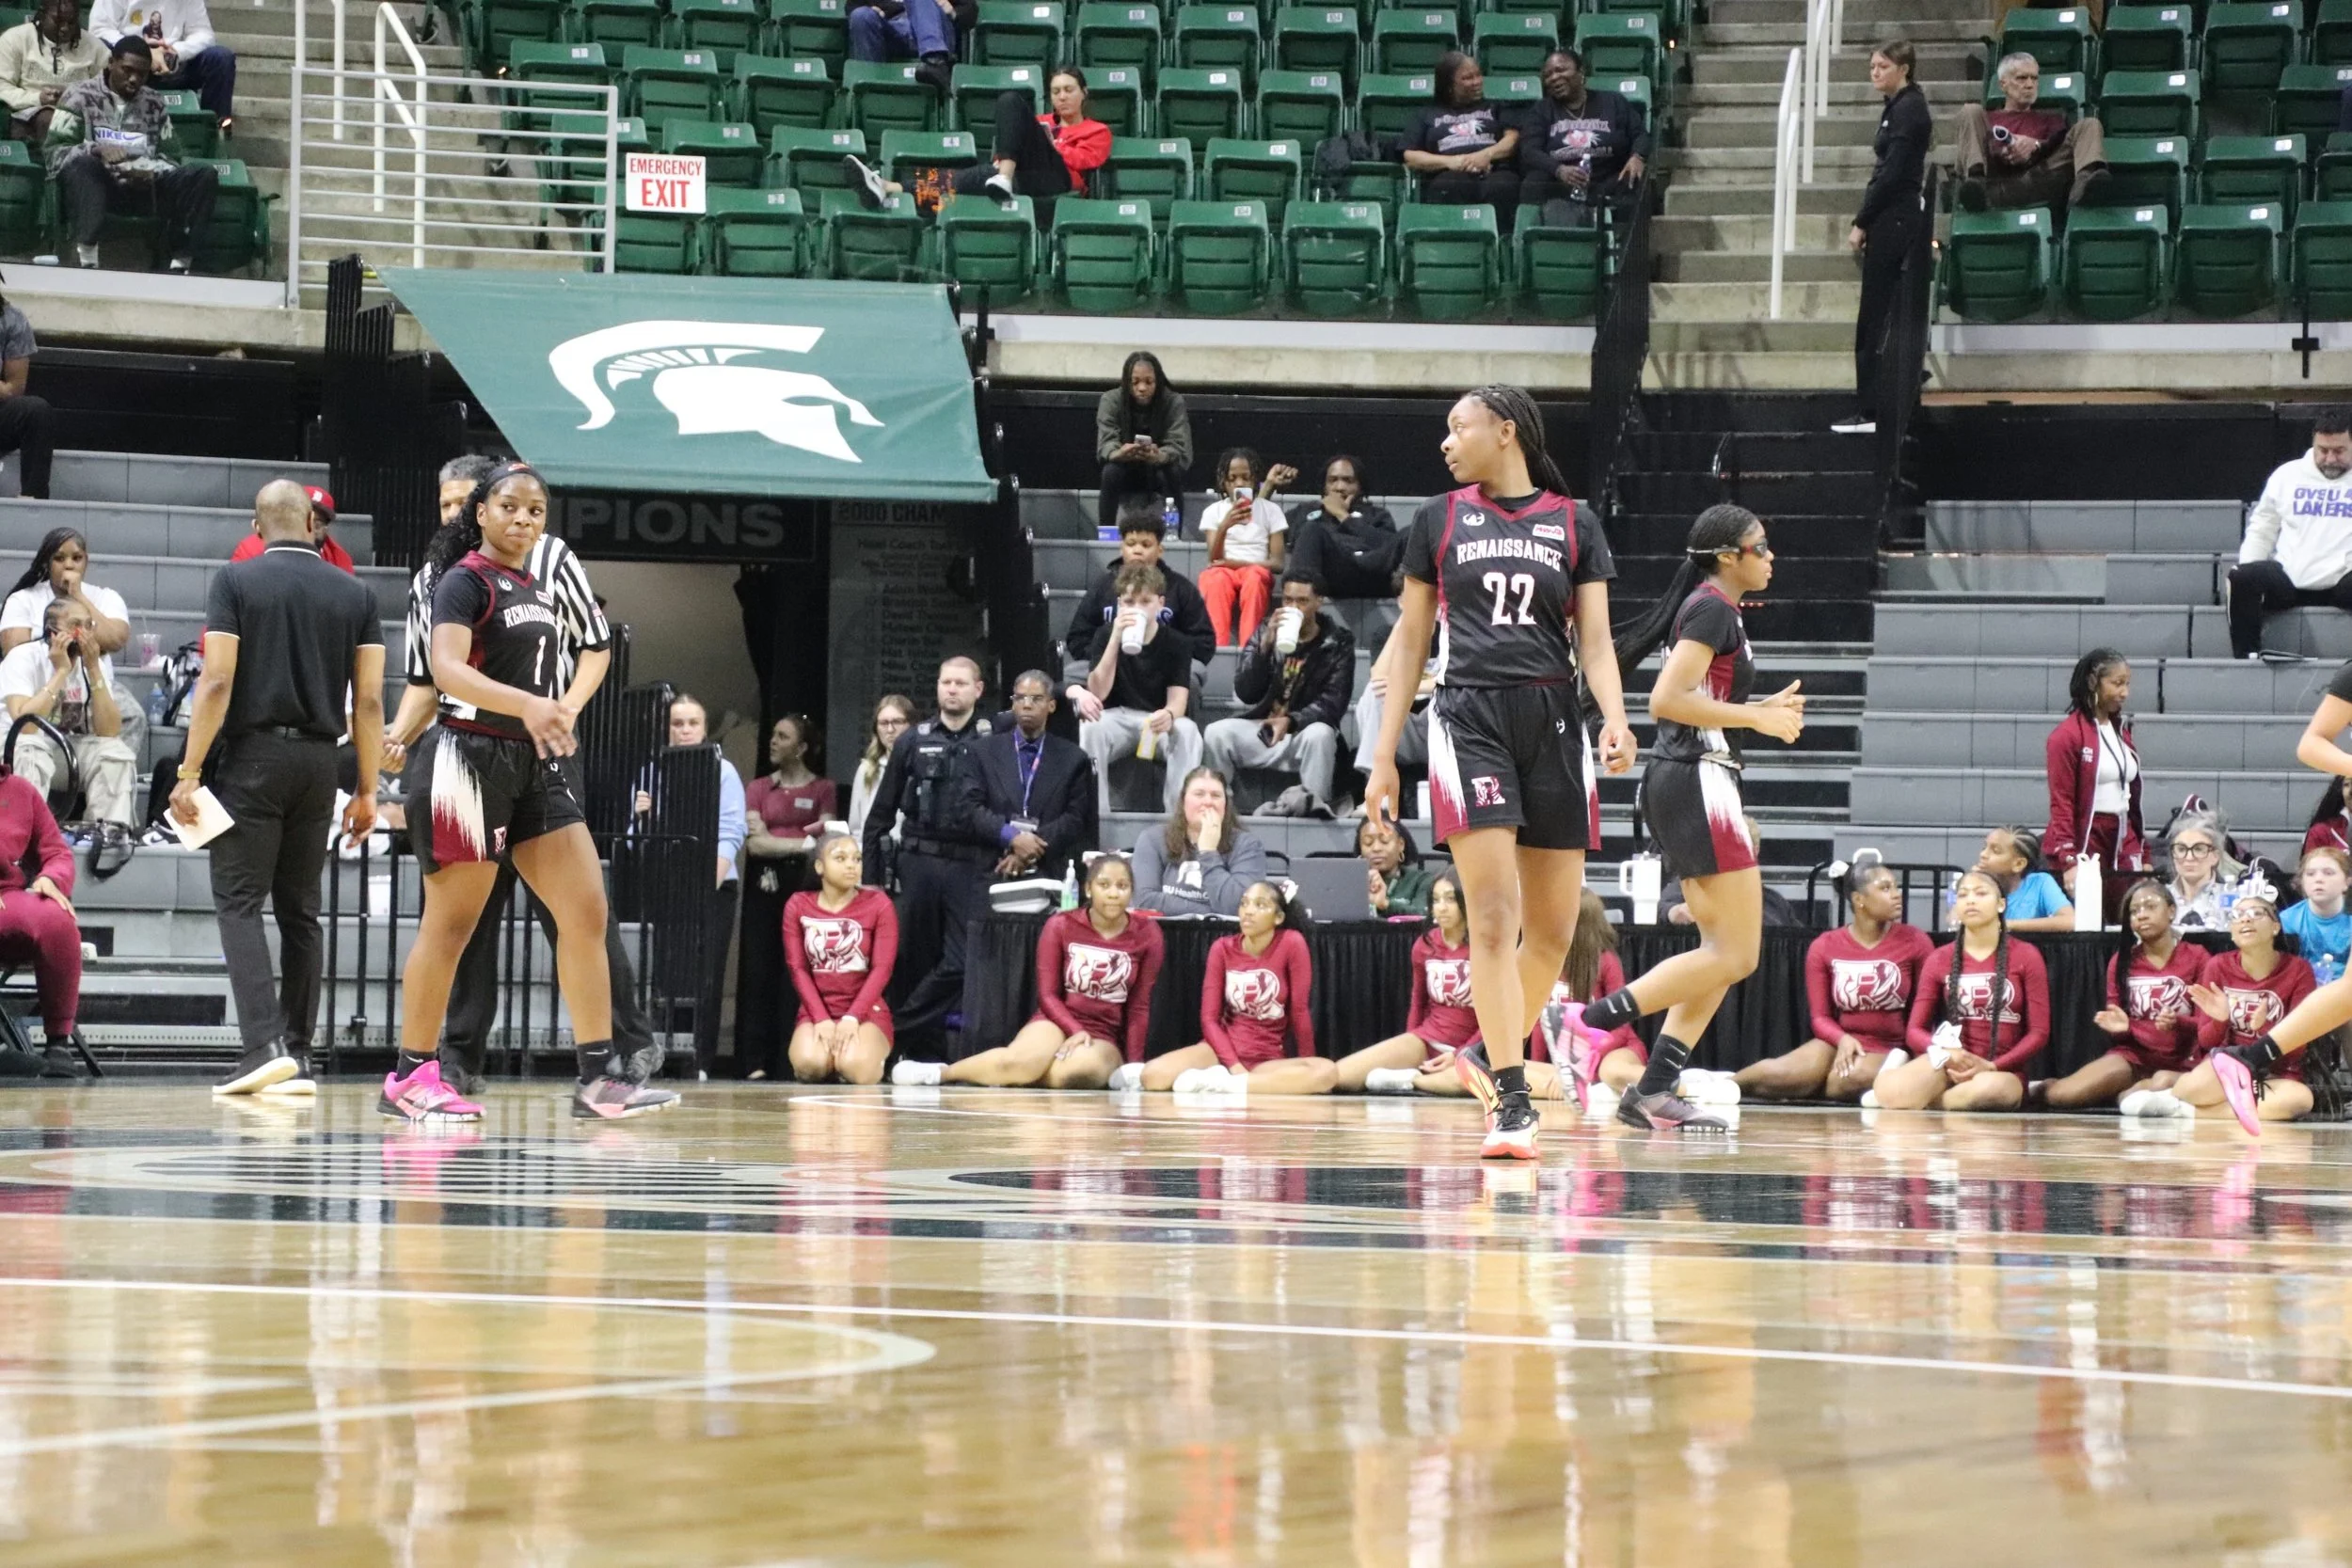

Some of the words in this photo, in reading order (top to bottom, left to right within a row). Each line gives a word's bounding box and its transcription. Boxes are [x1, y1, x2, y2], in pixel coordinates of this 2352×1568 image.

[95, 128, 123, 140] NIKE
[629, 157, 702, 176] EMERGENCY
[641, 178, 691, 208] EXIT
[1456, 537, 1563, 573] RENAISSANCE
[1482, 571, 1537, 626] 22
[533, 635, 548, 686] 1
